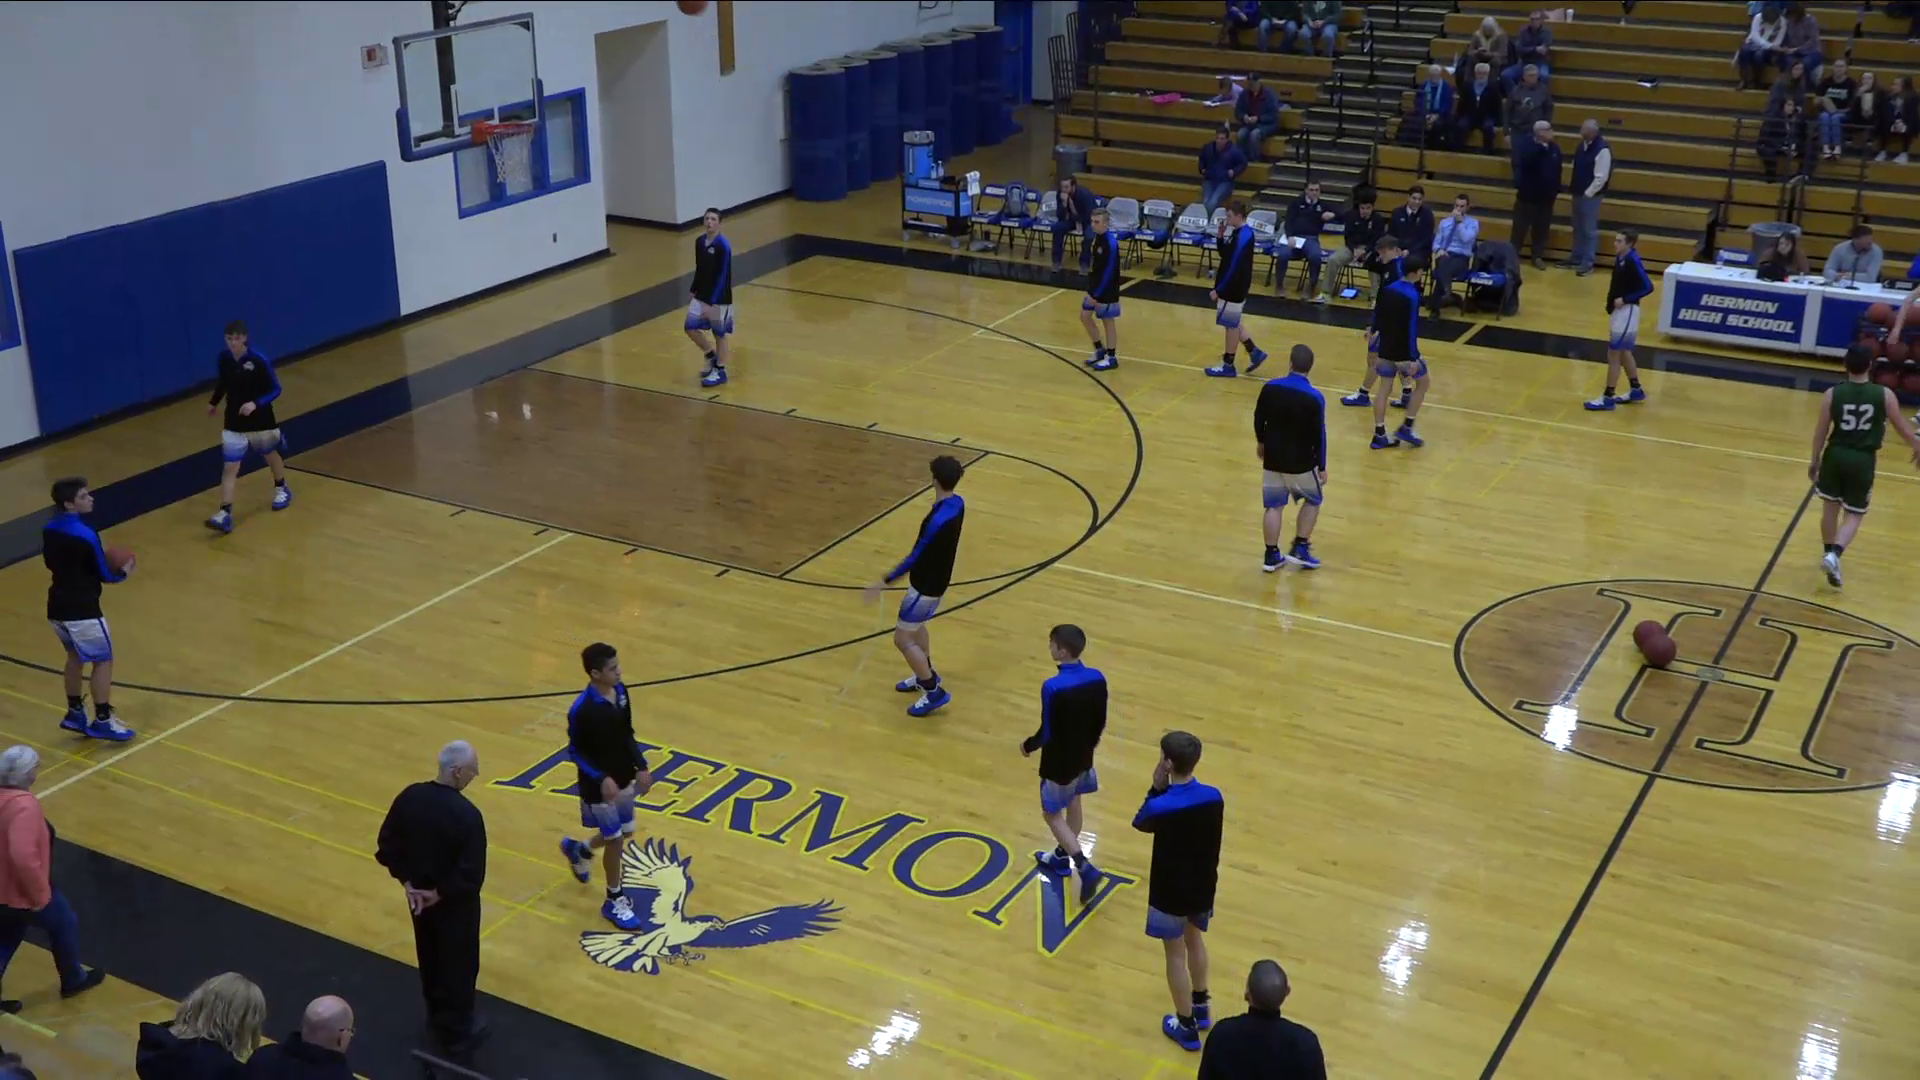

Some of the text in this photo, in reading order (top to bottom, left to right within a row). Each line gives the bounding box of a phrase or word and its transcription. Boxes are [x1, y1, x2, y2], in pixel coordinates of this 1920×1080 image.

[1701, 294, 1779, 314] HERMON
[1678, 309, 1795, 334] HIGH SCHOOL
[1839, 402, 1875, 431] 52
[1509, 586, 1898, 780] H
